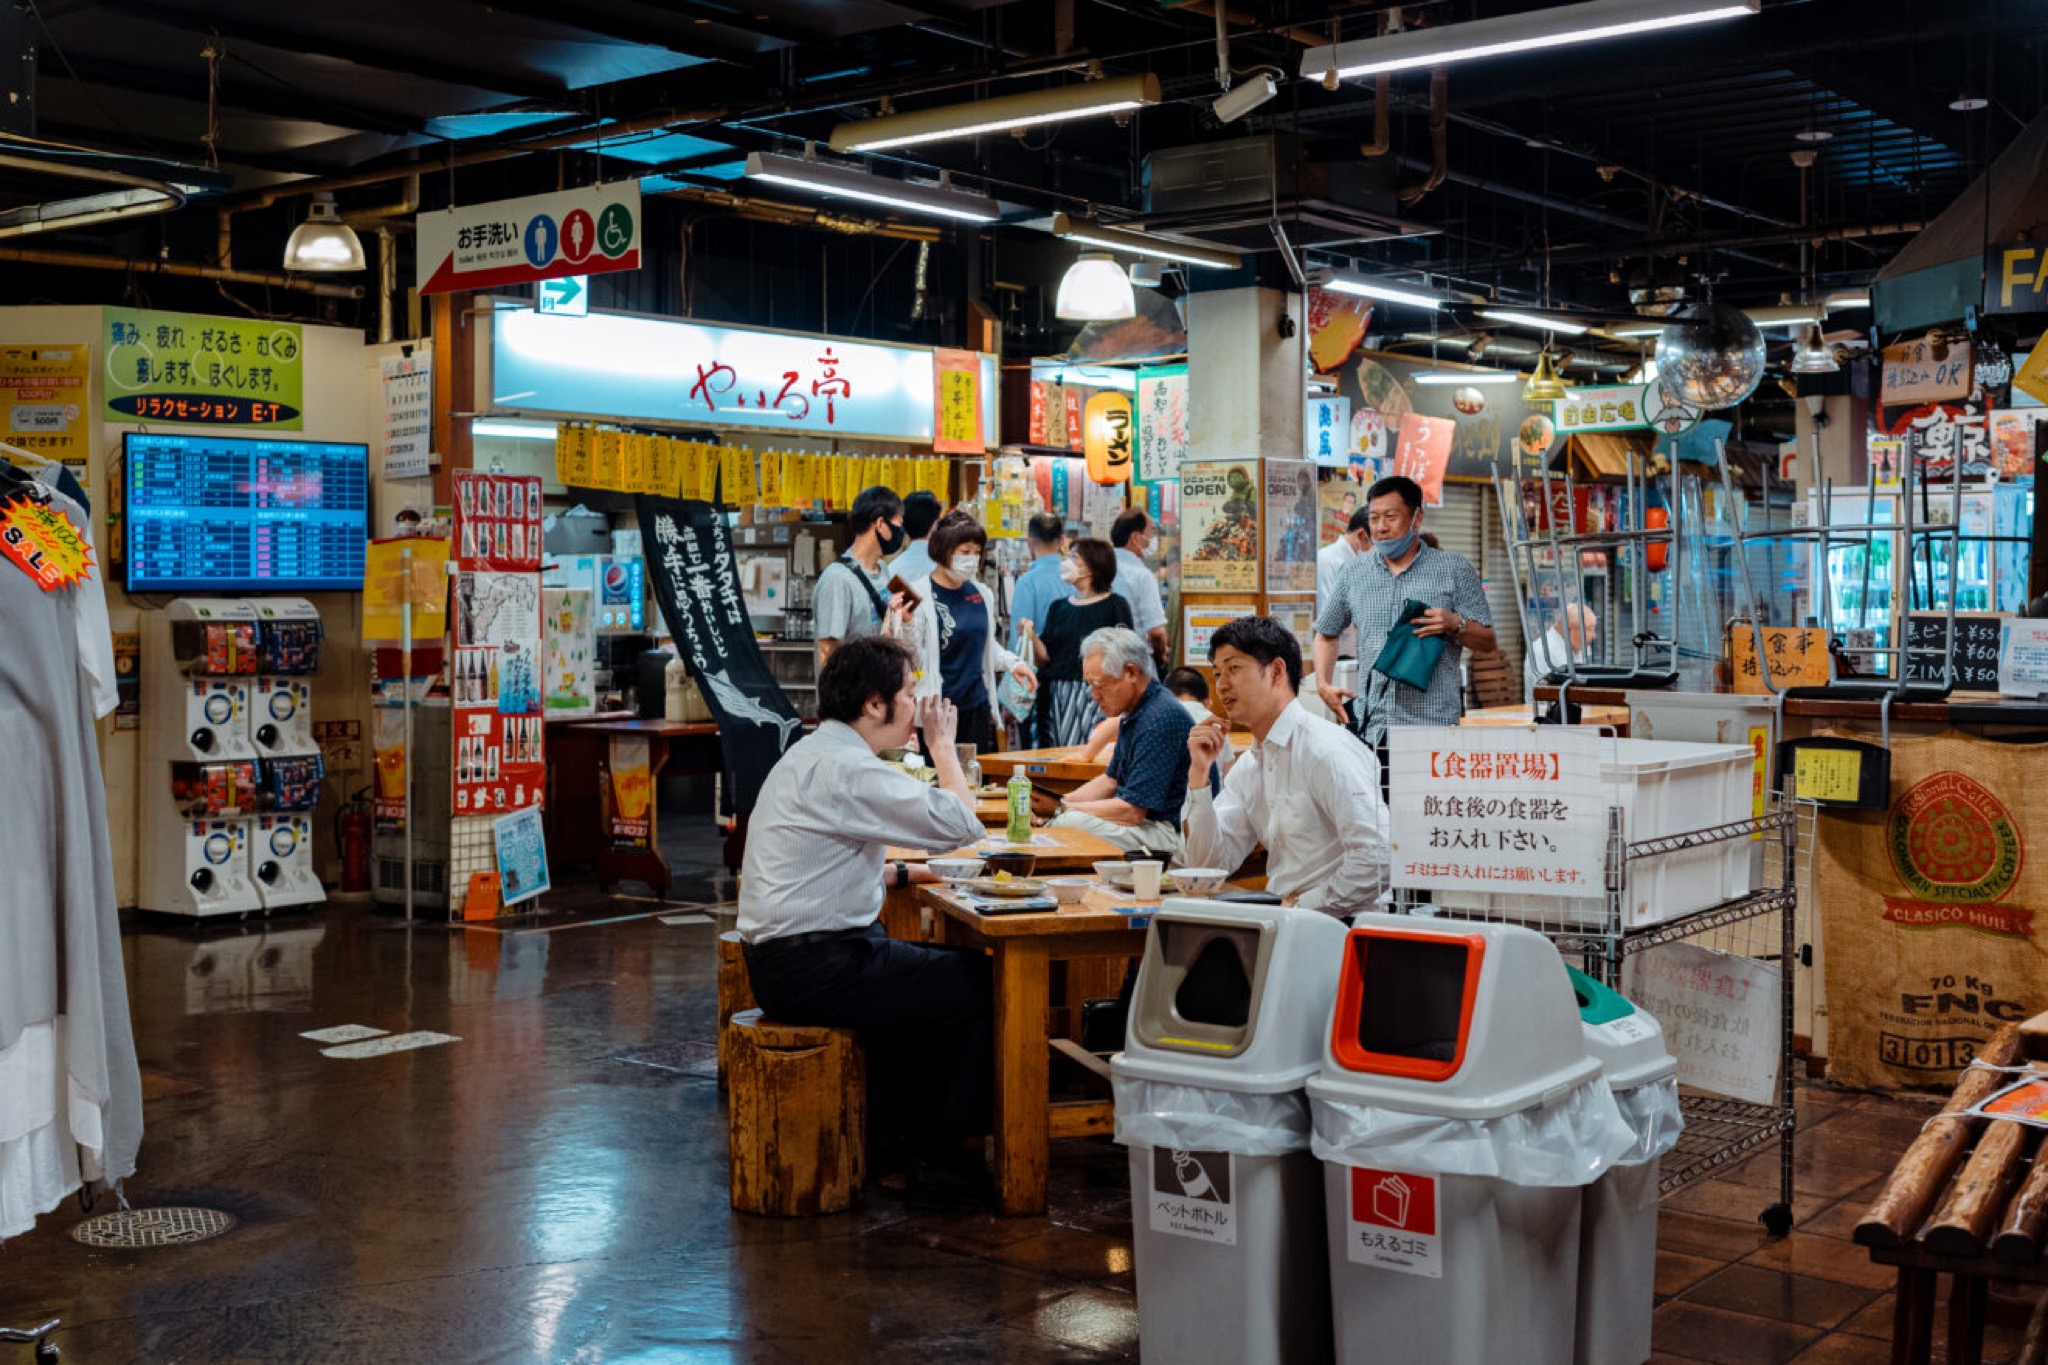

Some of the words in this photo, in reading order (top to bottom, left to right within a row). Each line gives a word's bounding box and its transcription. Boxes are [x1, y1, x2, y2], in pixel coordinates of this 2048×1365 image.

[458, 222, 518, 249] お手洗い
[136, 357, 197, 386] 癒します。
[209, 361, 279, 392] ほぐします。
[690, 347, 850, 425] やいろ亭
[136, 397, 238, 419] リラクゼーション
[1563, 401, 1636, 428] 自由広場
[1106, 410, 1129, 467] ラーメン
[1183, 483, 1227, 497] OPEN
[1267, 483, 1297, 497] OPEN
[4, 526, 62, 583] SALE
[710, 508, 742, 626] うちのタタキは
[1741, 656, 1802, 676] 持込み
[1964, 666, 2000, 682] ¥50
[1430, 751, 1560, 780] 【食器置場】
[1423, 795, 1568, 820] 飲食後の食器を
[1429, 826, 1557, 852] お入れ下さい。
[1405, 862, 1586, 885] ゴミはゴミ入れにお願いします。
[1934, 879, 1999, 899] SPECIALTY
[1893, 908, 1964, 924] CLASICO
[1969, 910, 2017, 932] HUIL
[1930, 975, 1955, 991] 70
[1965, 975, 1993, 996] Kg
[1901, 992, 2026, 1022] FNC
[1886, 1040, 1901, 1061] 3
[1915, 1043, 1944, 1065] 01
[1157, 1201, 1228, 1225] ペットボトル
[1361, 1231, 1427, 1256] もえるゴミ
